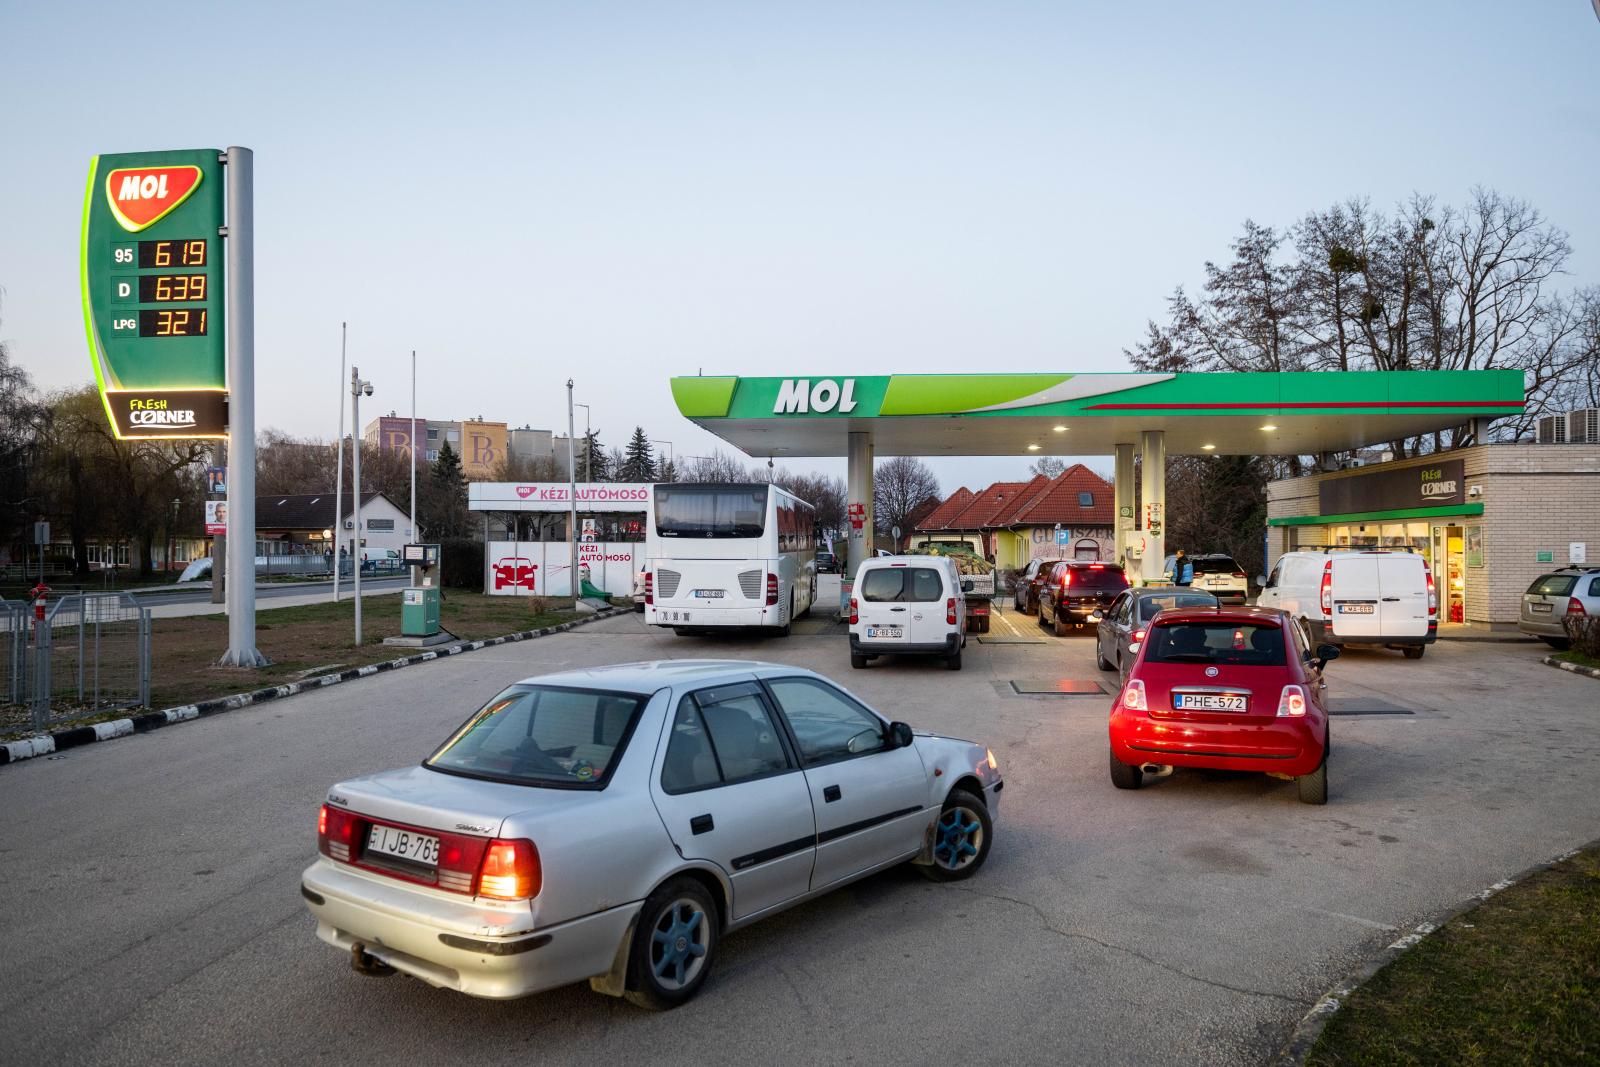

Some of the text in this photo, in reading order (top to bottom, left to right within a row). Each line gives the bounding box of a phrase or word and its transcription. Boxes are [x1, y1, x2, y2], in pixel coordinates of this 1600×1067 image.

[118, 174, 169, 200] MOL
[115, 241, 206, 266] 95 619
[118, 276, 206, 301] D 639
[113, 310, 206, 335] LPG 321
[130, 399, 167, 410] FRESH
[773, 379, 857, 413] MOL
[1421, 470, 1442, 481] FRESH
[540, 487, 648, 500] KÉZI AUTÓMOSÓ
[579, 544, 598, 552] KÉZI
[580, 553, 631, 561] AUTÓ MOSÓ
[1184, 696, 1243, 709] PHE-572
[381, 829, 439, 862] IJB-765
